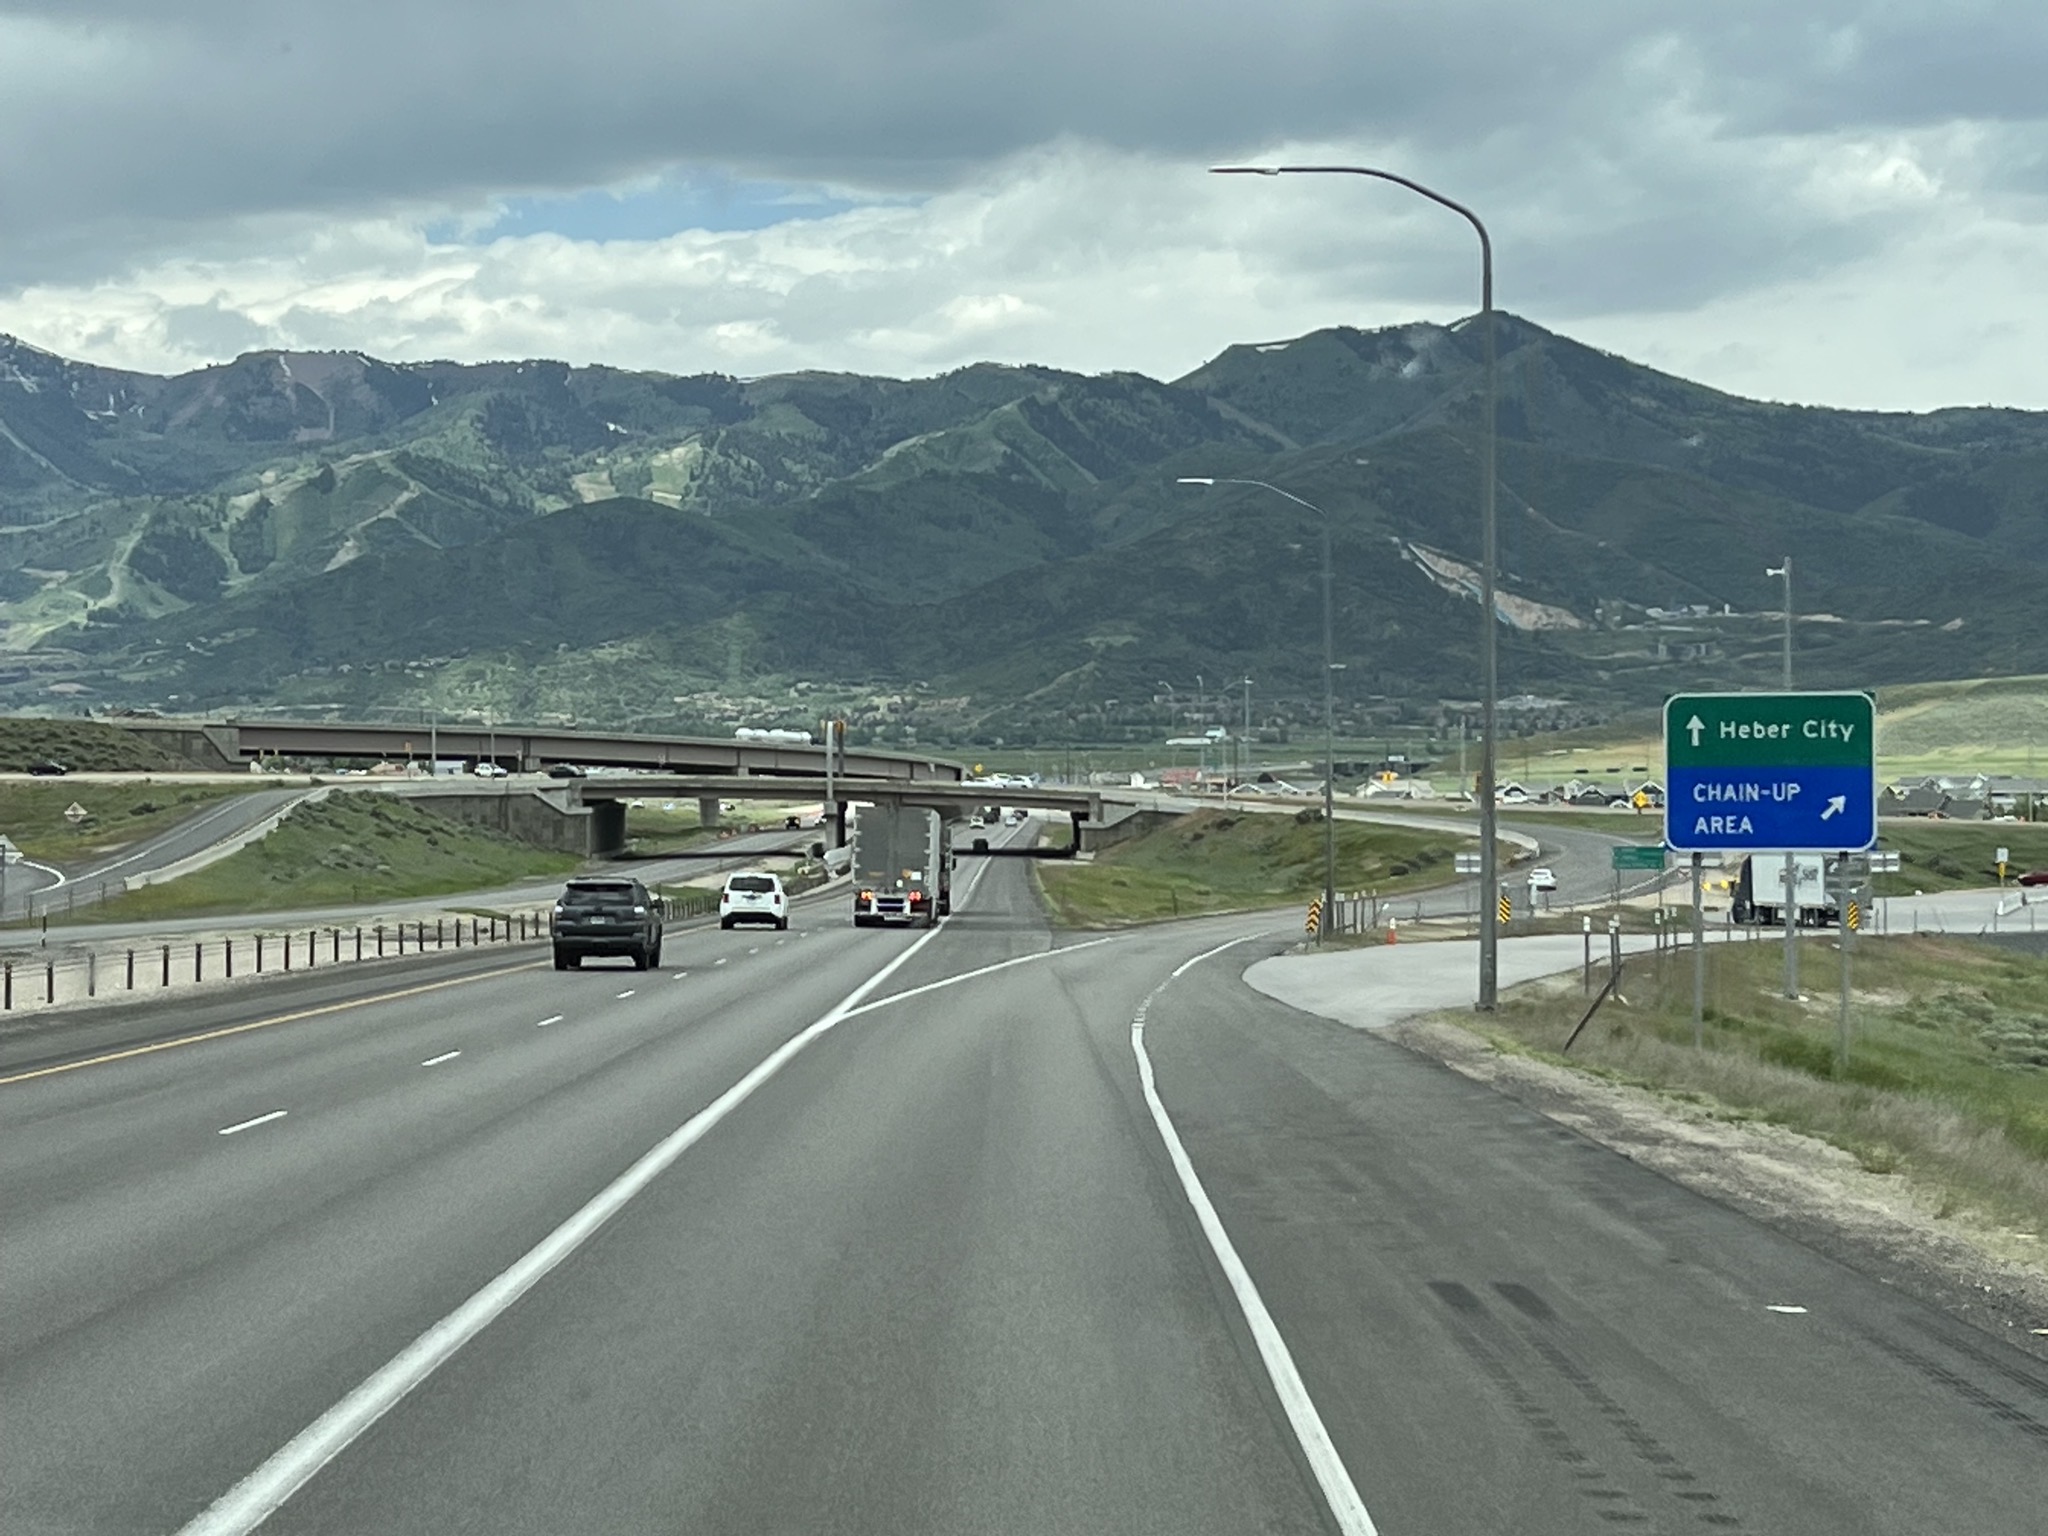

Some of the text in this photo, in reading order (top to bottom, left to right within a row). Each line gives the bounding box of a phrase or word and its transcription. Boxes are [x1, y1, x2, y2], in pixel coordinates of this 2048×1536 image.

[1719, 719, 1855, 743] Heber City
[1692, 782, 1801, 802] CHAIN-UP
[1694, 816, 1754, 834] AREA
